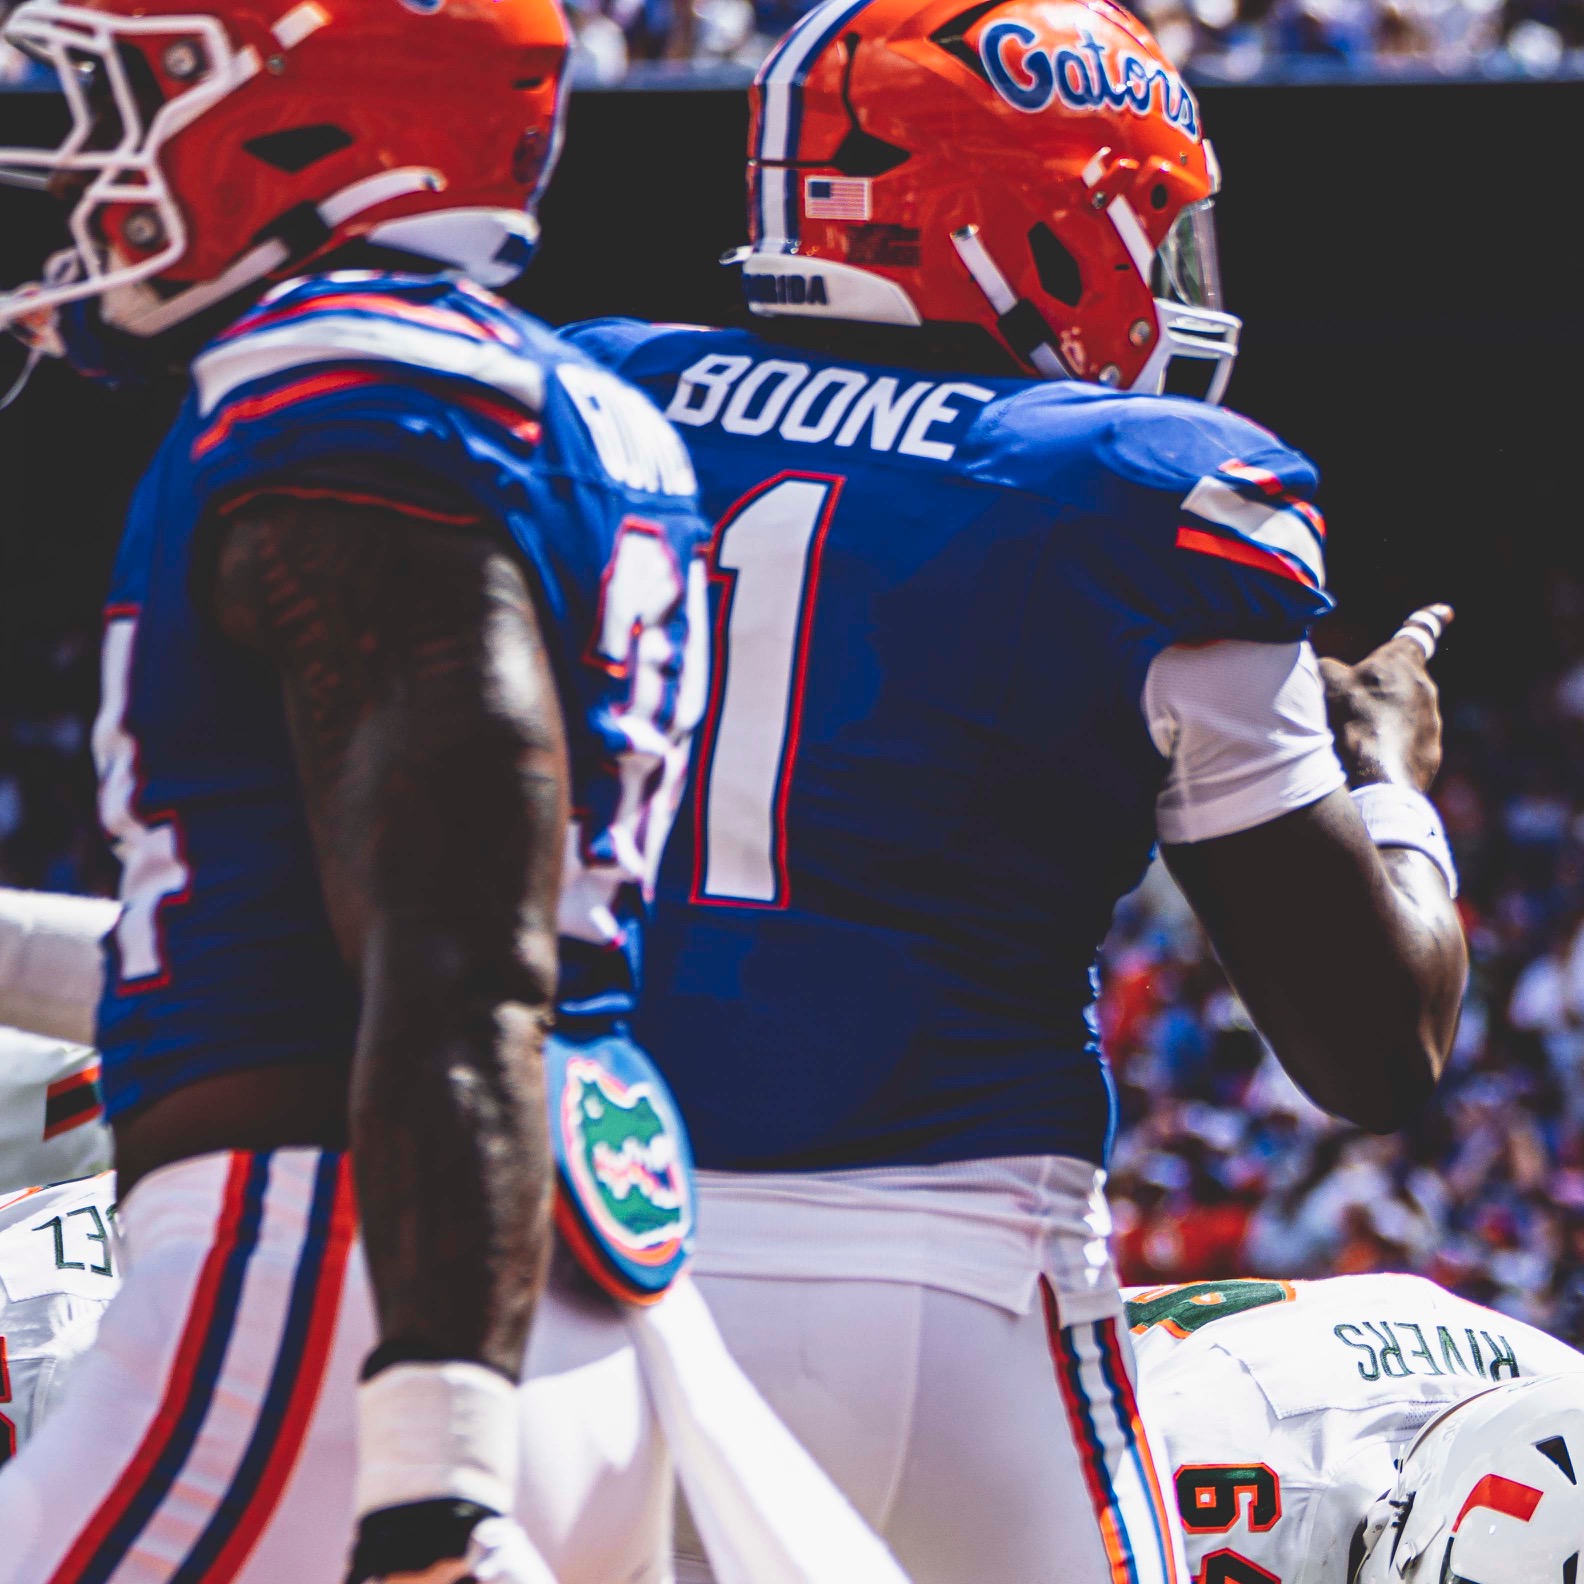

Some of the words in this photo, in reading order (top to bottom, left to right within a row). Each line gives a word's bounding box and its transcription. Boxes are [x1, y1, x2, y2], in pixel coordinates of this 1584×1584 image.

[978, 18, 1201, 144] Gators
[664, 353, 996, 463] BOONE
[1334, 1321, 1520, 1382] RIVERS
